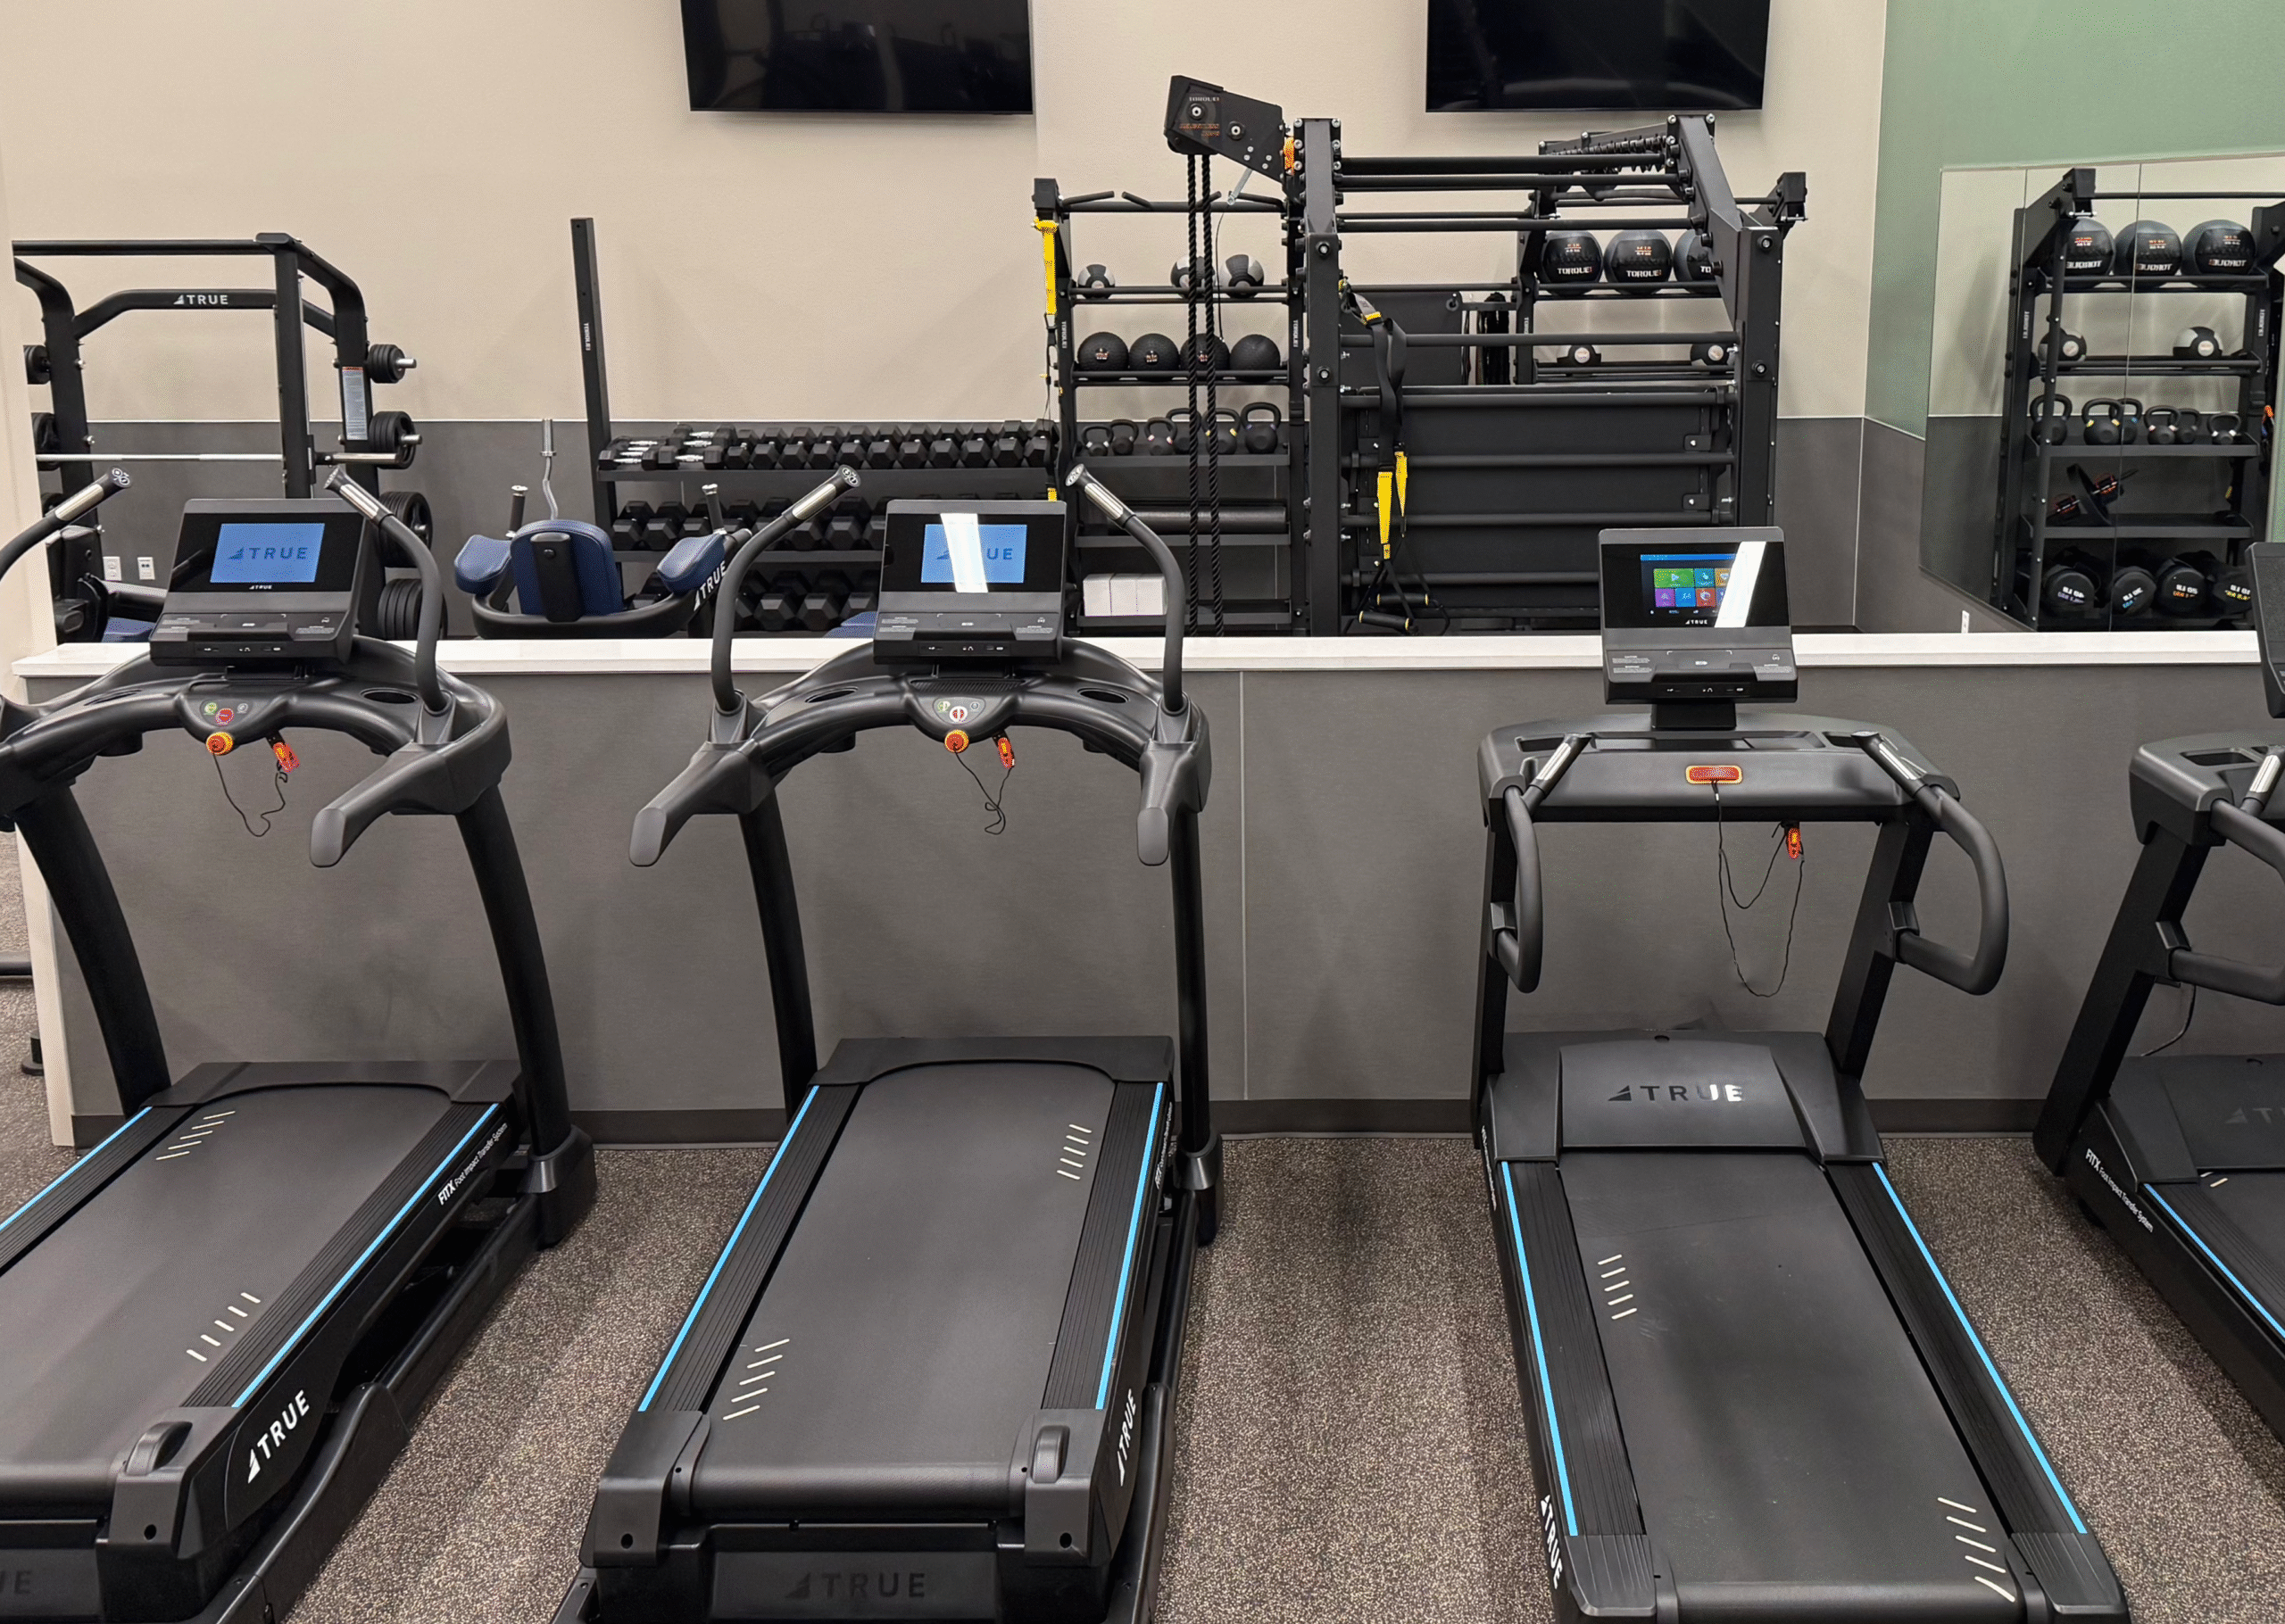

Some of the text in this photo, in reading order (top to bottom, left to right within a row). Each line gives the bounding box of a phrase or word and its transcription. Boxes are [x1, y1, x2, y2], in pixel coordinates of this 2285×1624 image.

[1557, 267, 1592, 275] TORQUE
[1626, 269, 1662, 278] TORQUE
[186, 294, 228, 305] TRUE
[249, 547, 308, 560] TRUE
[700, 559, 727, 600] TRUE
[1640, 1083, 1745, 1103] TRUE
[437, 1180, 456, 1206] FITX
[453, 1172, 466, 1188] Foot
[463, 1156, 480, 1176] Impact
[492, 1123, 508, 1141] System
[2085, 1148, 2102, 1172] FITX
[256, 1389, 310, 1460] TRUE
[1118, 1388, 1136, 1462] TRUE
[1543, 1503, 1563, 1590] TRUE
[820, 1572, 926, 1599] TRUE
